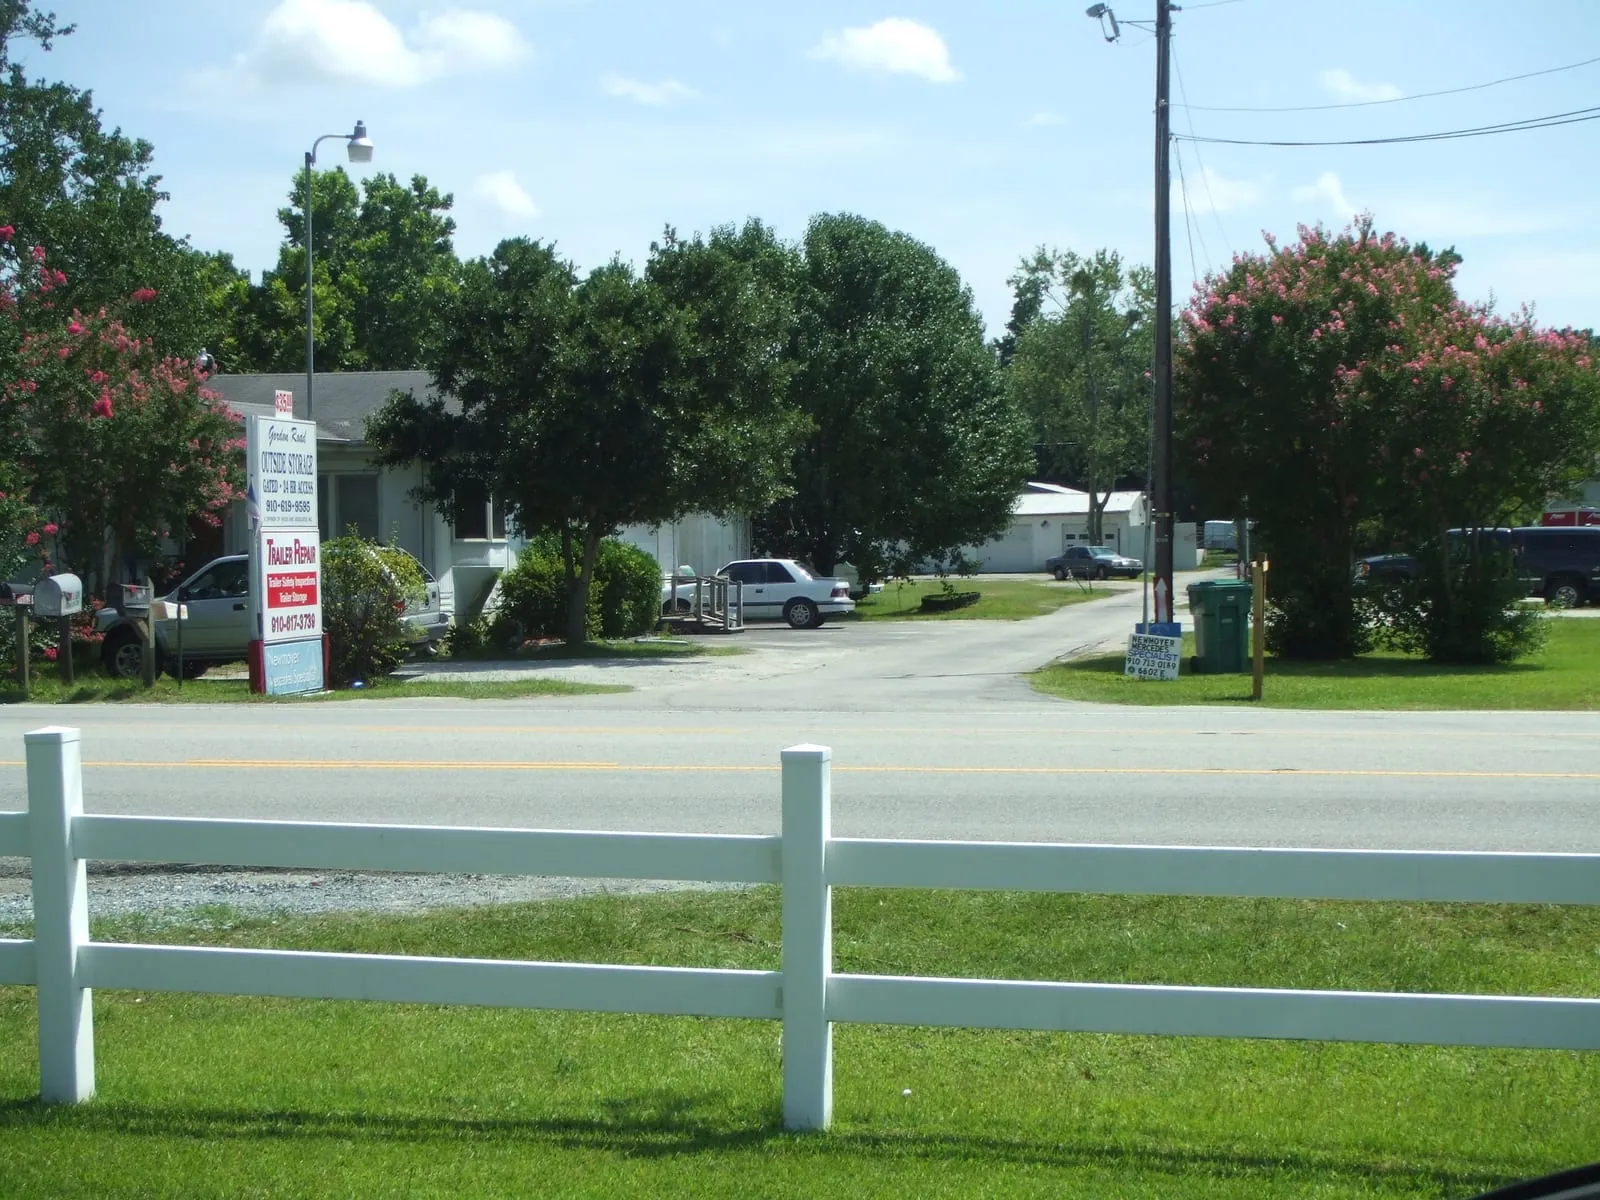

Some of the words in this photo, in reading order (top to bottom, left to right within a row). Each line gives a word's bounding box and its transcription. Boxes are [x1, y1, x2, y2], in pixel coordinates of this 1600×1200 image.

[268, 425, 289, 446] Gordon
[291, 427, 307, 444] Road
[262, 451, 286, 474] OUTSIDE
[288, 452, 313, 476] STORAGE
[263, 479, 278, 493] GATED
[289, 480, 297, 494] HR
[298, 480, 313, 495] ACCESS
[268, 577, 282, 588] Trailer
[282, 576, 295, 589] Safety
[279, 592, 292, 603] Trailer
[292, 591, 308, 604] Storage
[1131, 635, 1175, 648] NEWMOYER
[1131, 643, 1169, 654] MERCEDES
[1127, 649, 1179, 662] SPECIALIST
[1127, 657, 1141, 666] 910
[1142, 658, 1156, 667] 713
[1138, 667, 1158, 676] 6602
